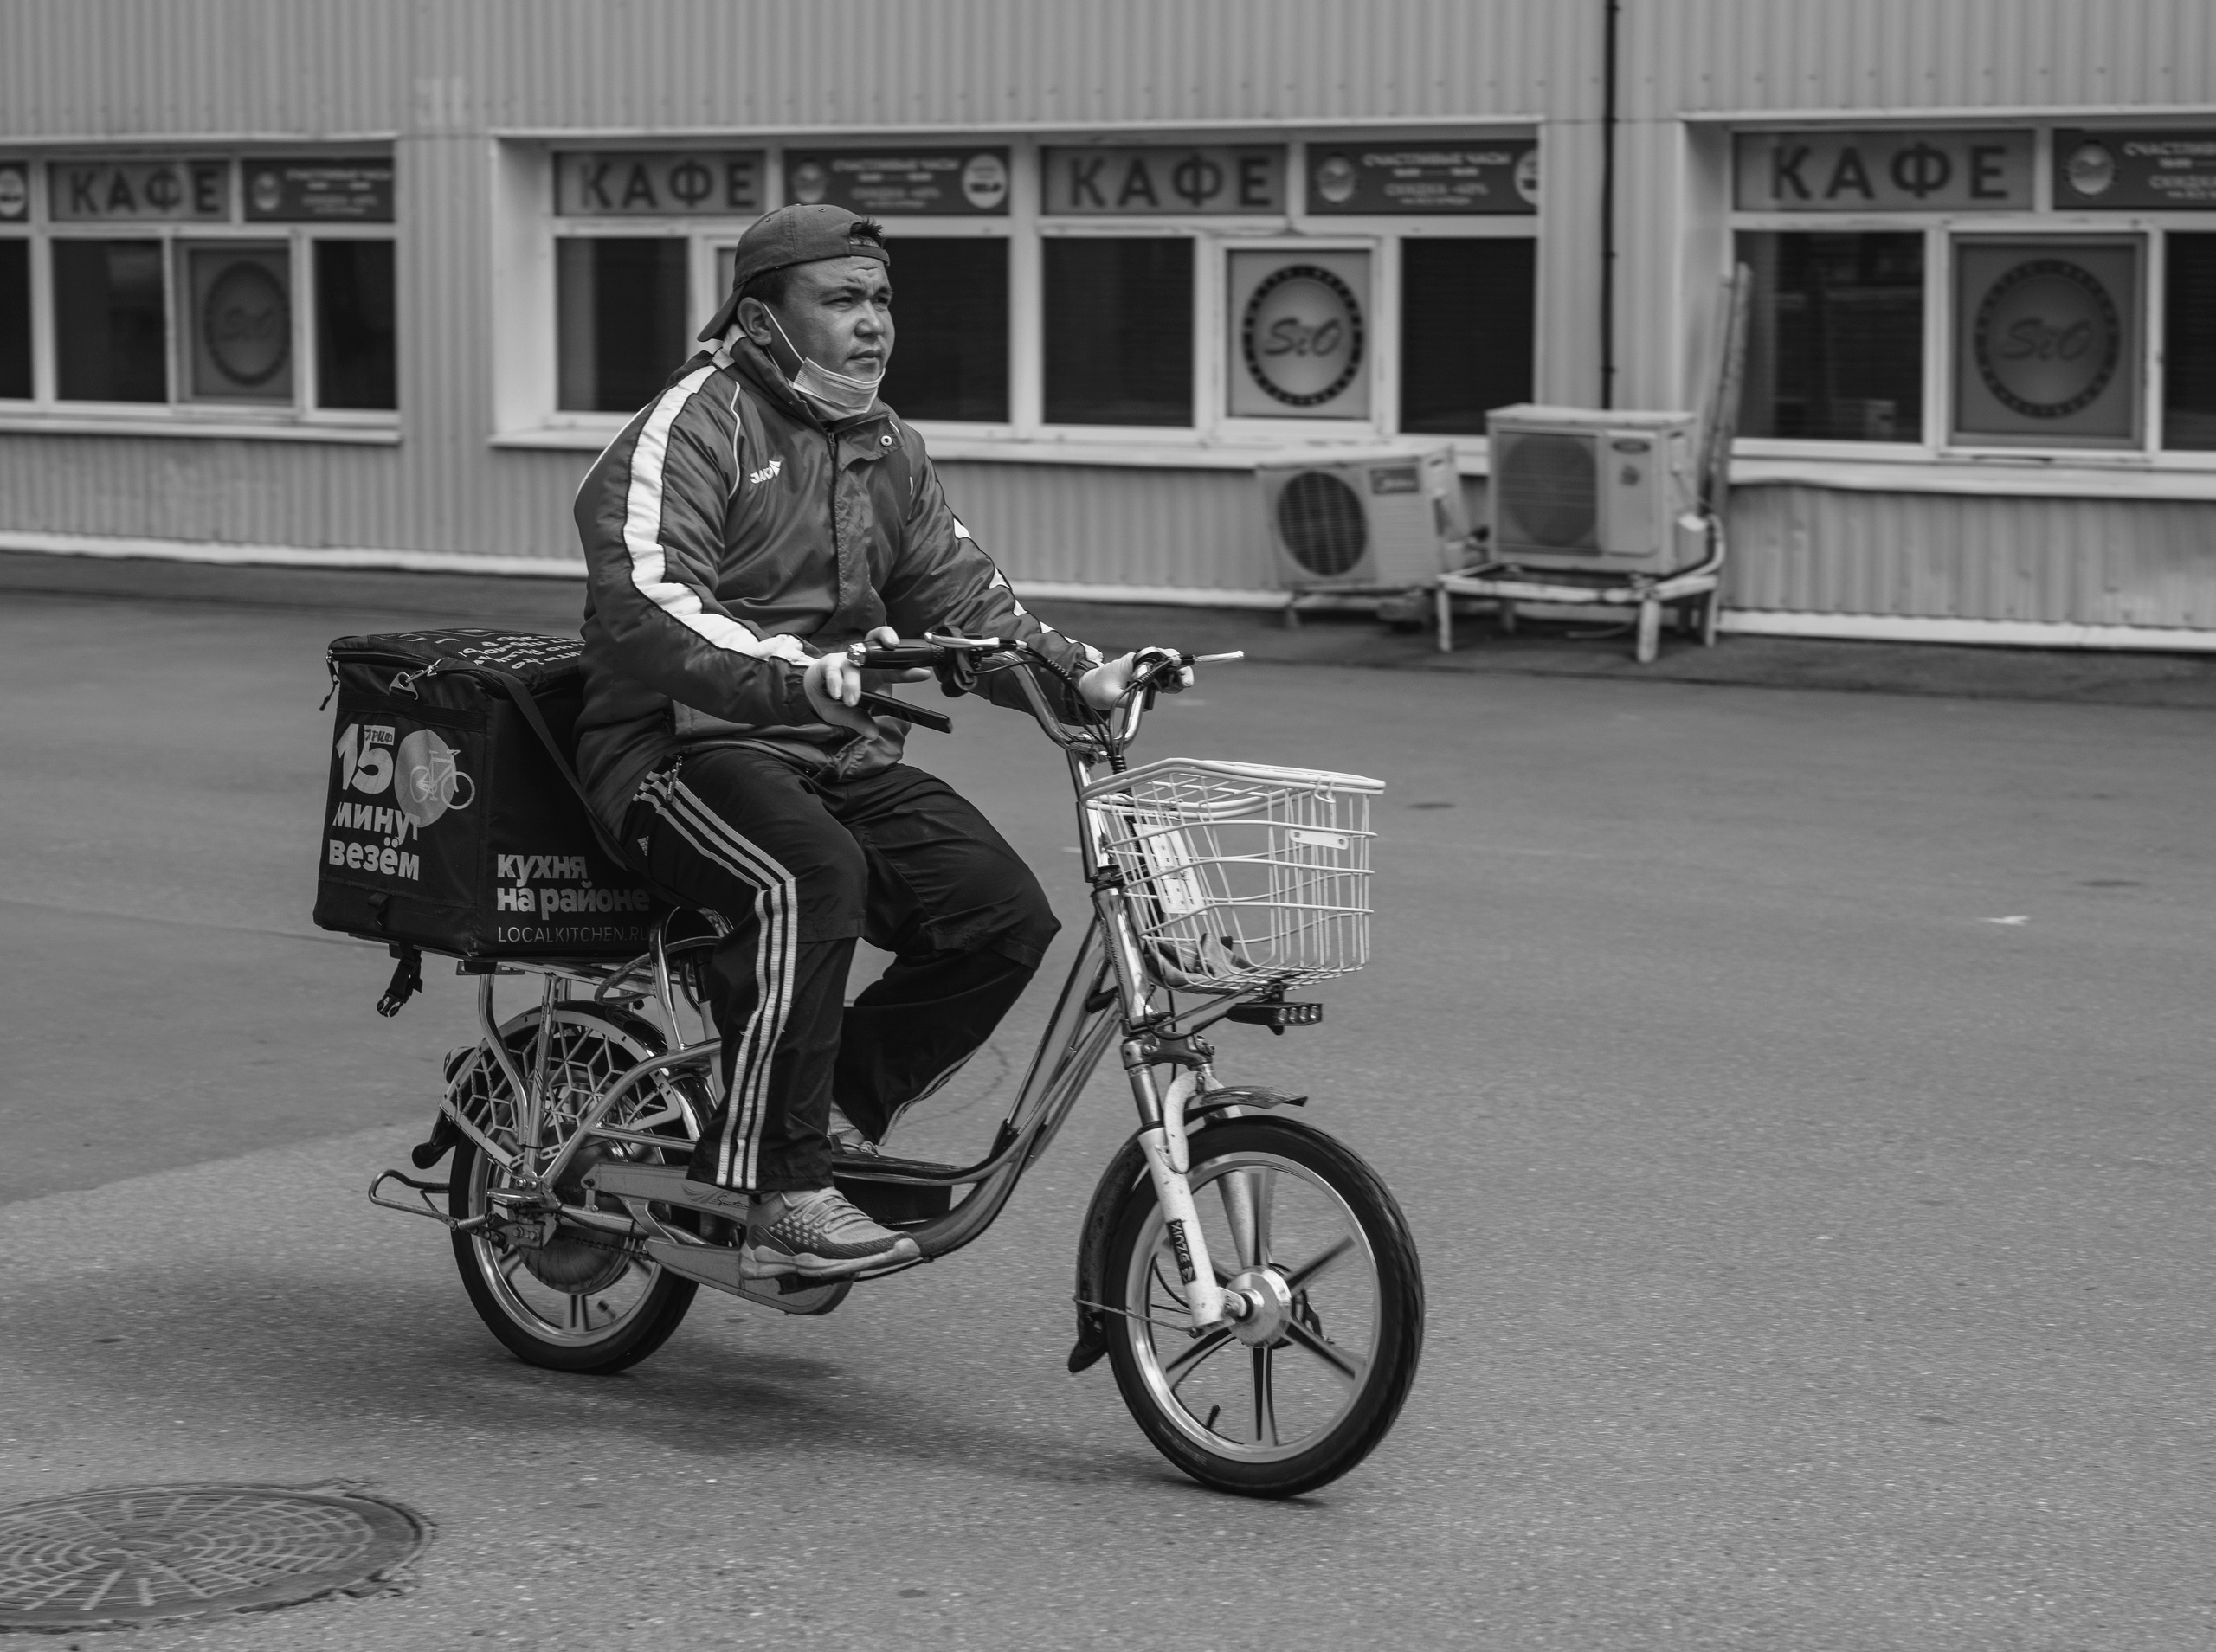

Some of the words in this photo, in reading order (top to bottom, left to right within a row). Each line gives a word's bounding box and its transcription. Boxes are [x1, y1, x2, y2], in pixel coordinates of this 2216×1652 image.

[70, 168, 222, 215] КАФЕ
[581, 158, 757, 208] КАФЕ
[1069, 154, 1272, 208] КАФЕ
[1770, 141, 2008, 200] КАФЕ
[332, 802, 421, 845] минут
[329, 836, 420, 881] везём
[497, 854, 589, 886] кухня
[497, 888, 537, 912] на
[540, 880, 650, 920] районе
